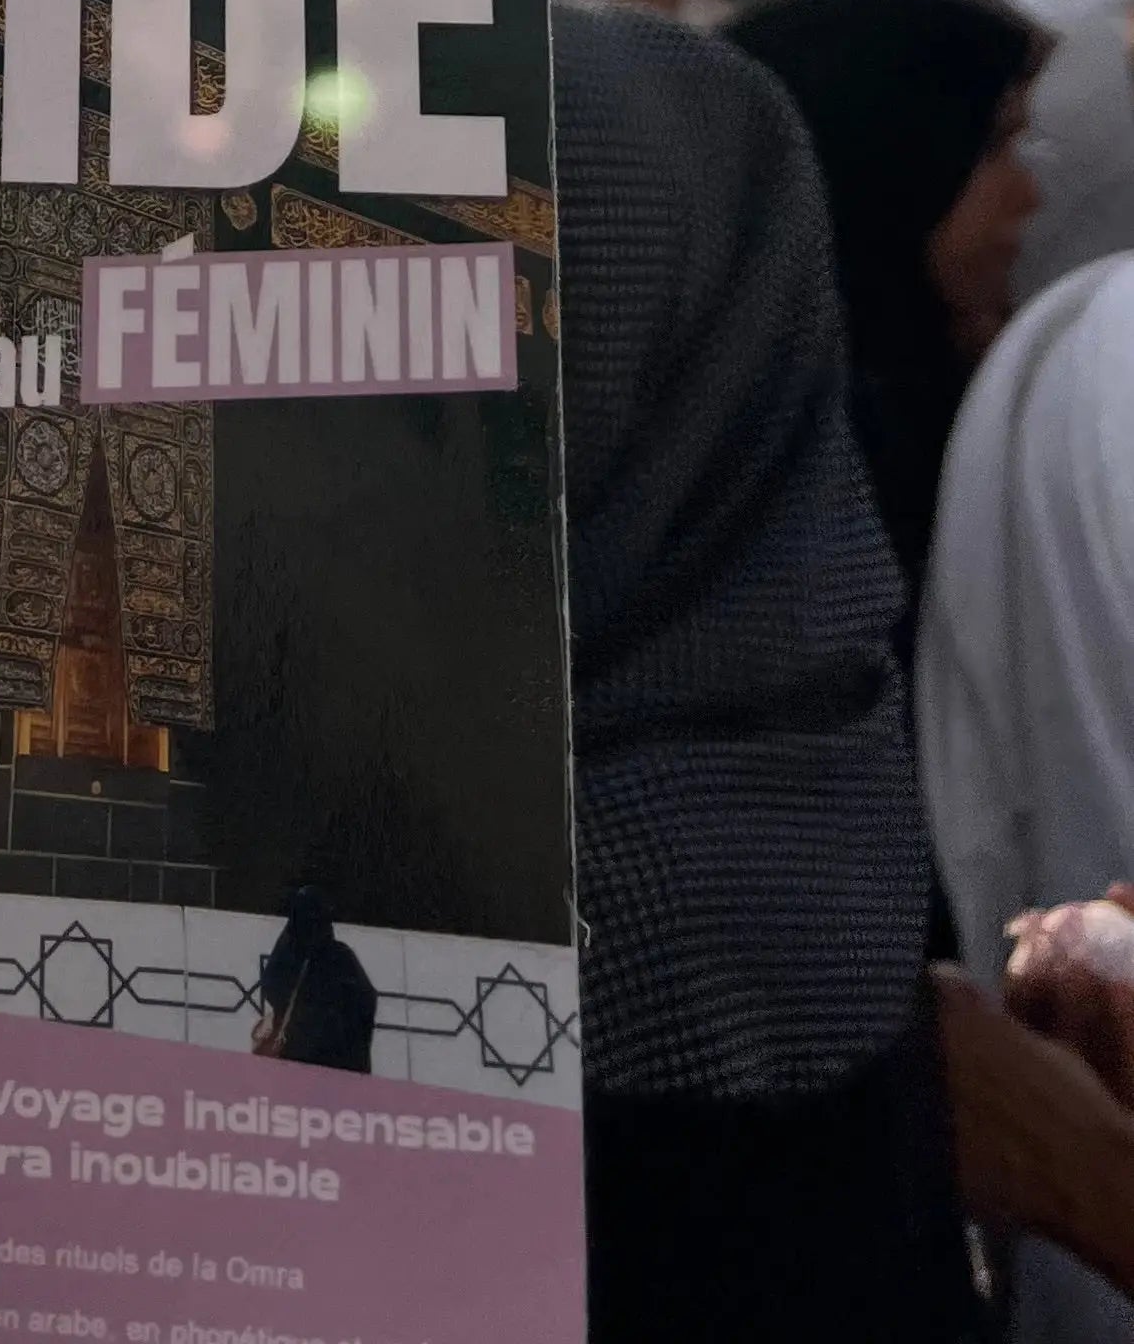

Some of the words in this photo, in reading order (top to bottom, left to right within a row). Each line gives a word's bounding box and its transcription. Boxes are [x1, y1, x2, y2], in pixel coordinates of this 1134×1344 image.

[97, 232, 502, 389] FÉMININ
[71, 1141, 340, 1200] inoubliable
[56, 1243, 140, 1275] rituels
[148, 1249, 183, 1279] de
[193, 1252, 217, 1283] la
[226, 1255, 304, 1291] Omra
[126, 1320, 160, 1344] en
